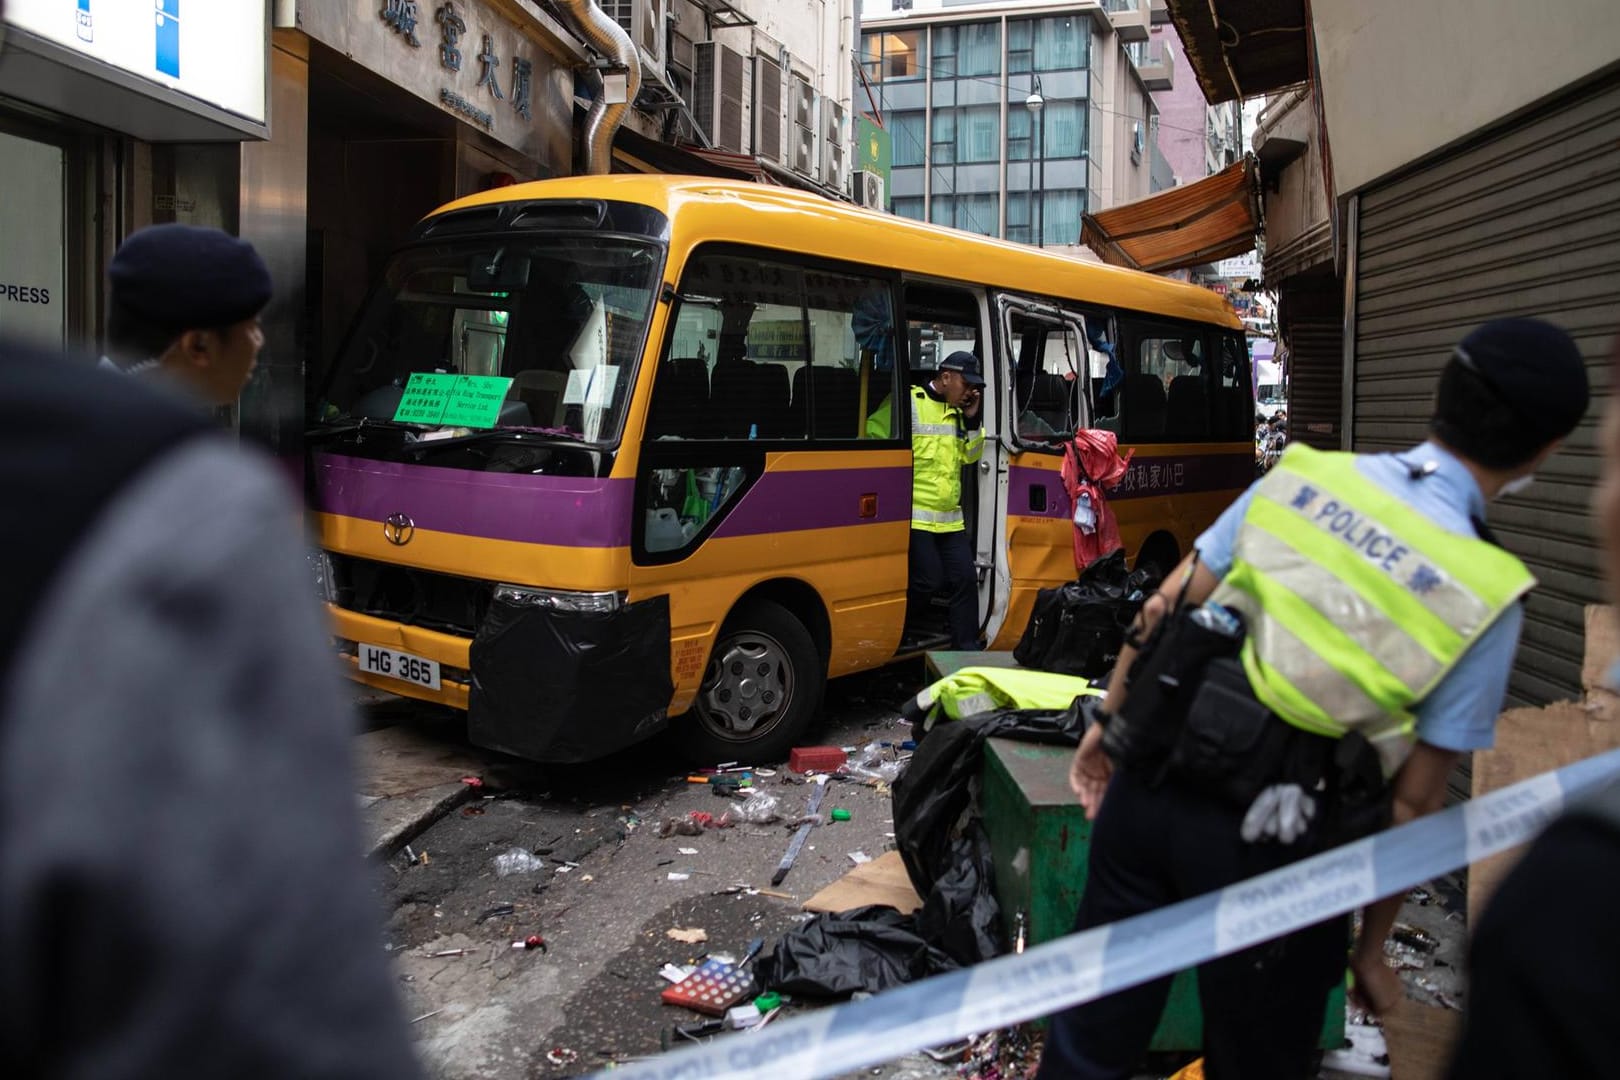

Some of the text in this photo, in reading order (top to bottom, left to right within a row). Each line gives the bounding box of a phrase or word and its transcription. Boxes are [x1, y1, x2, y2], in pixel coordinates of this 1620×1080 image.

[1314, 501, 1409, 571] POLICE
[368, 648, 431, 684] HG 365
